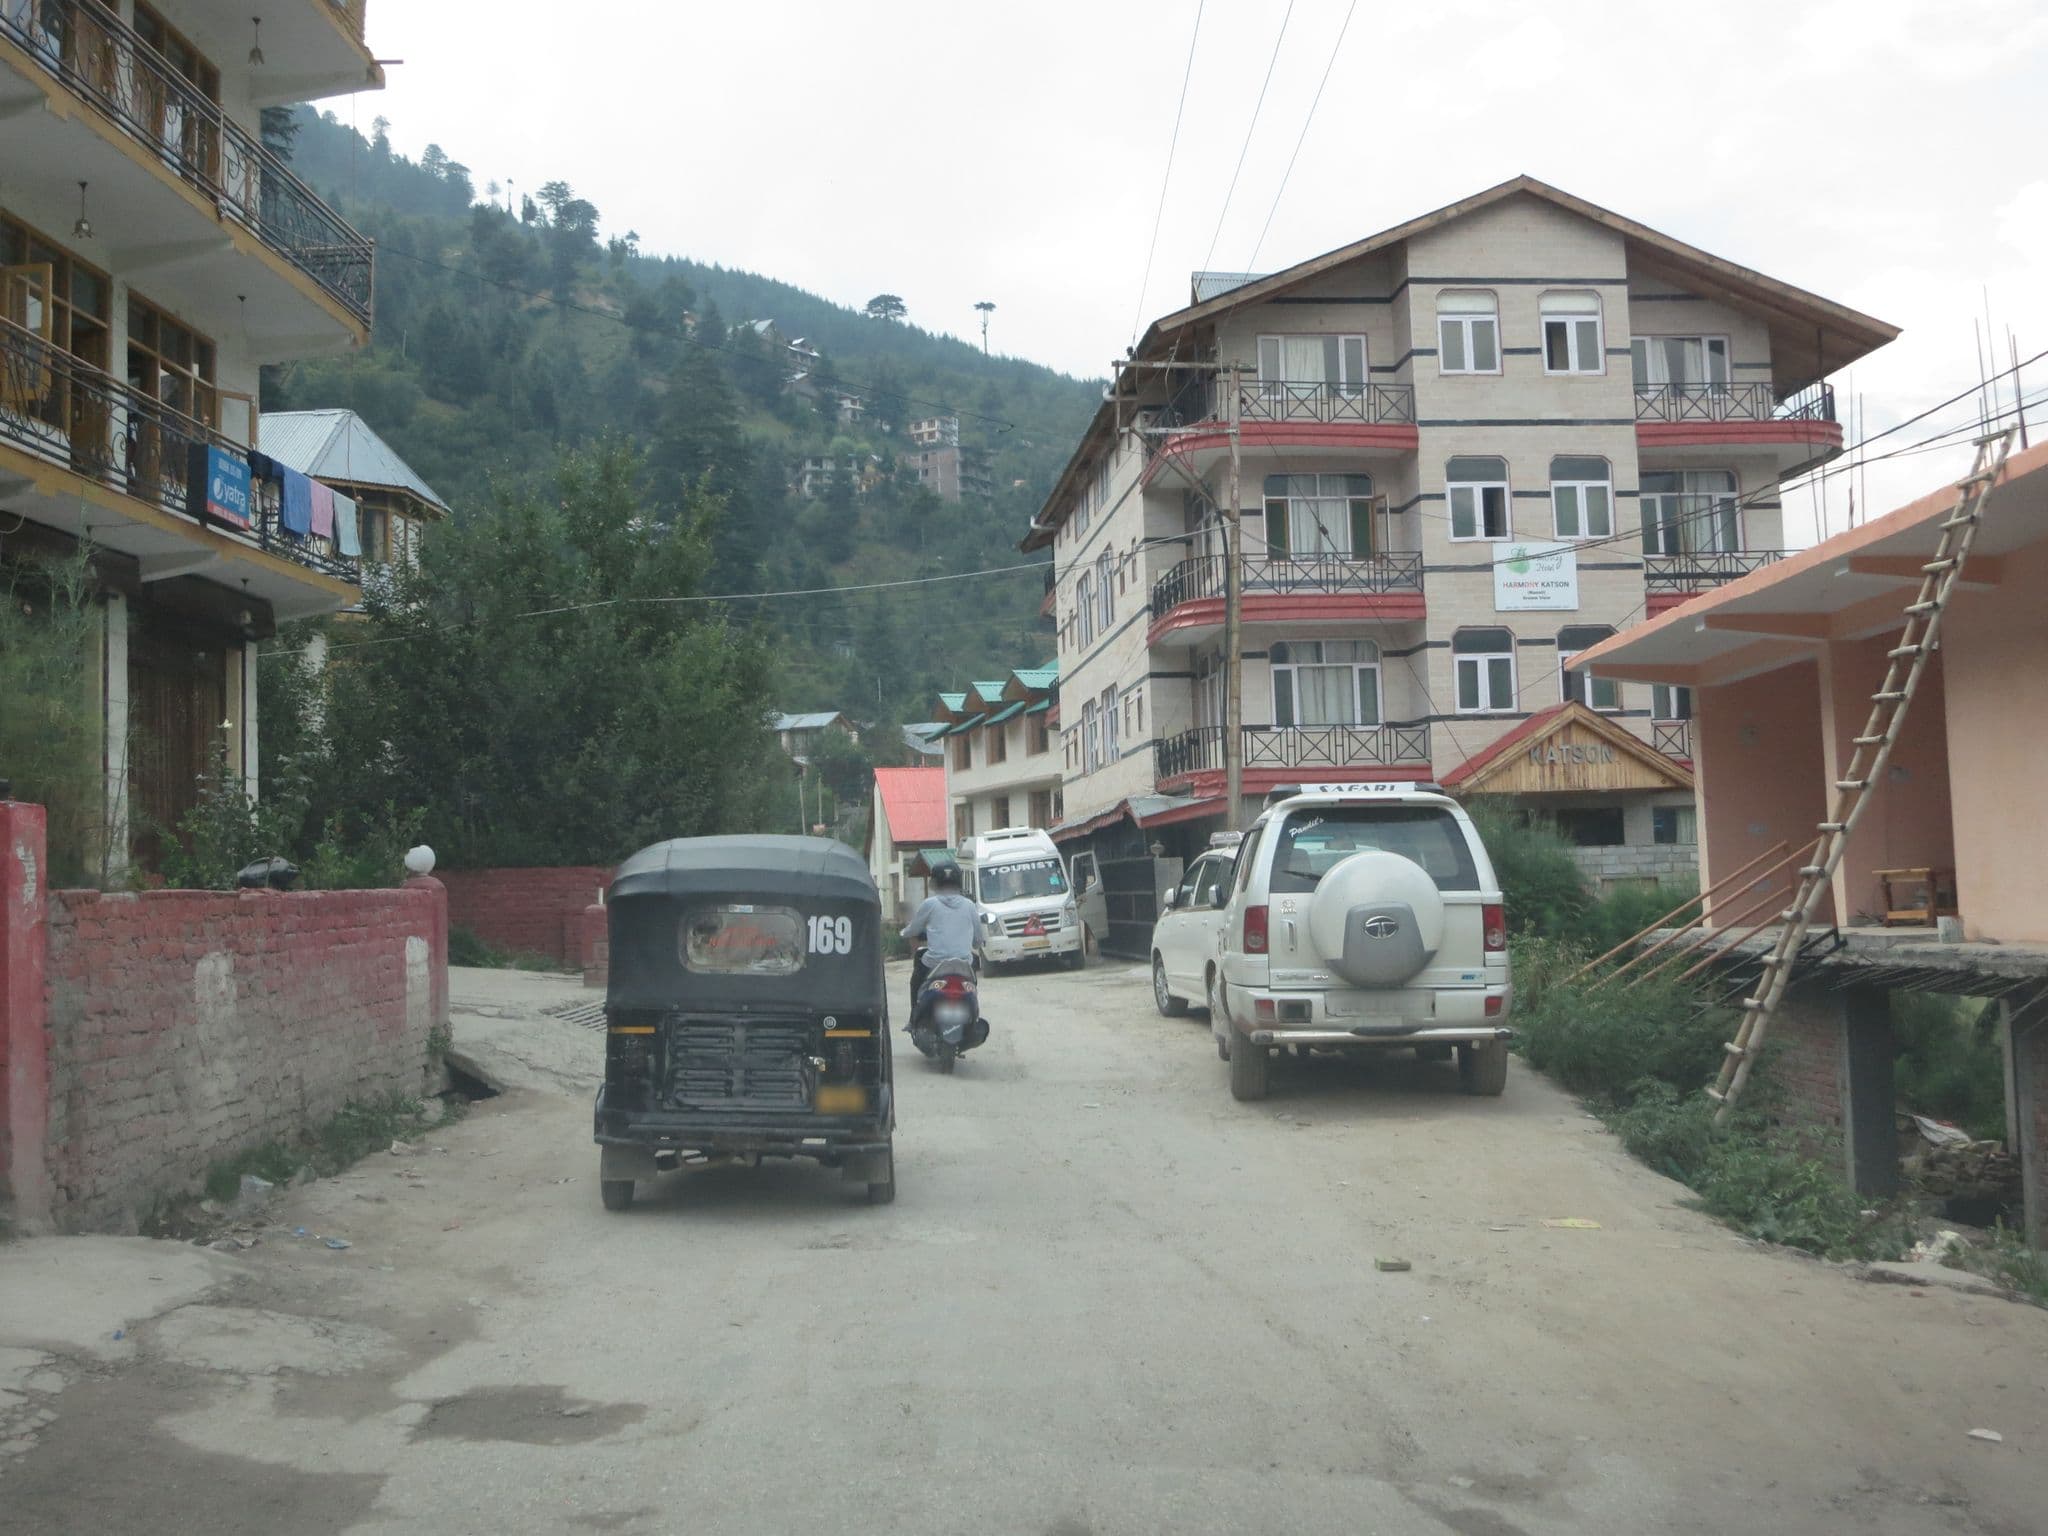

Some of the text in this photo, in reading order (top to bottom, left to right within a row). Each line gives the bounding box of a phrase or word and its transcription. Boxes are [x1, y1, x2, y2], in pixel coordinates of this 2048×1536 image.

[224, 483, 246, 506] yatra
[1503, 581, 1539, 589] HARMONY
[1529, 743, 1614, 766] KATSON
[1319, 784, 1396, 793] SAFARI
[1289, 816, 1325, 838] Pandit's
[988, 860, 1056, 876] TOURIST
[808, 915, 852, 955] 169
